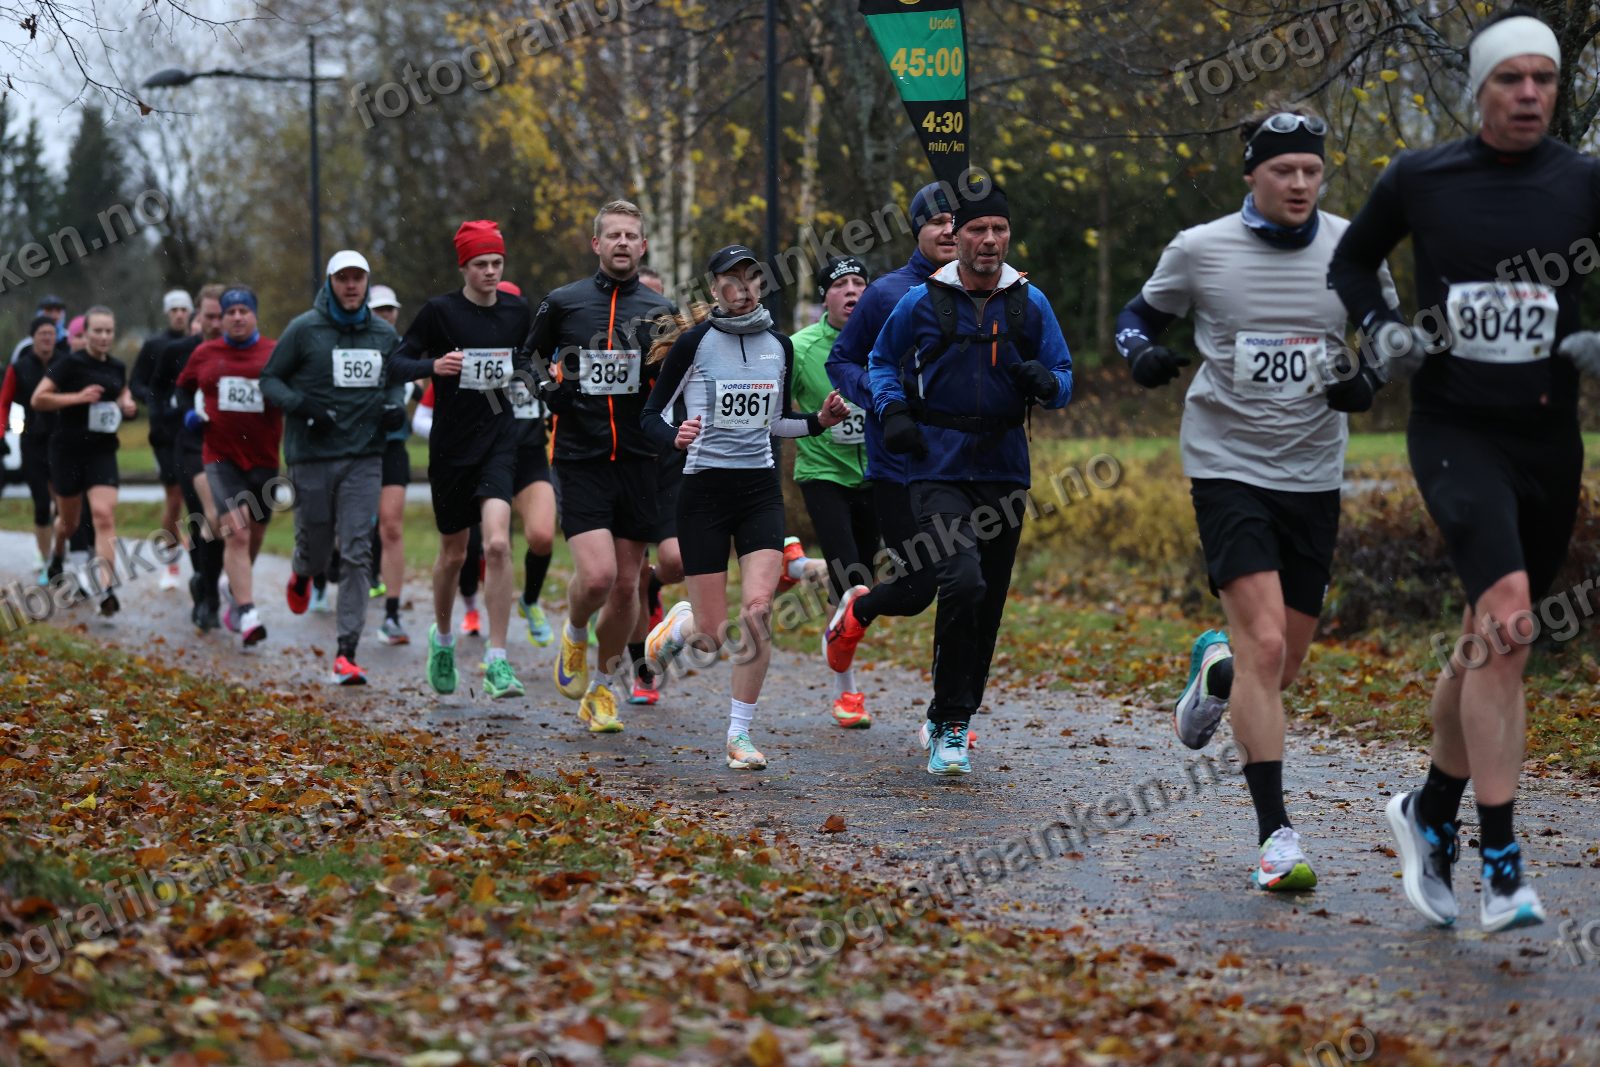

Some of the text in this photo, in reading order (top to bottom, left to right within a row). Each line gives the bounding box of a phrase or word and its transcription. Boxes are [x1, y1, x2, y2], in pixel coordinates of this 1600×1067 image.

[890, 46, 963, 77] 45:00
[922, 111, 963, 133] 4:30
[1460, 306, 1545, 342] 3042
[343, 360, 373, 379] 562
[474, 360, 504, 380] 165
[591, 363, 628, 384] 385
[1252, 350, 1307, 383] 280
[228, 386, 256, 405] 824
[721, 392, 771, 417] 9361
